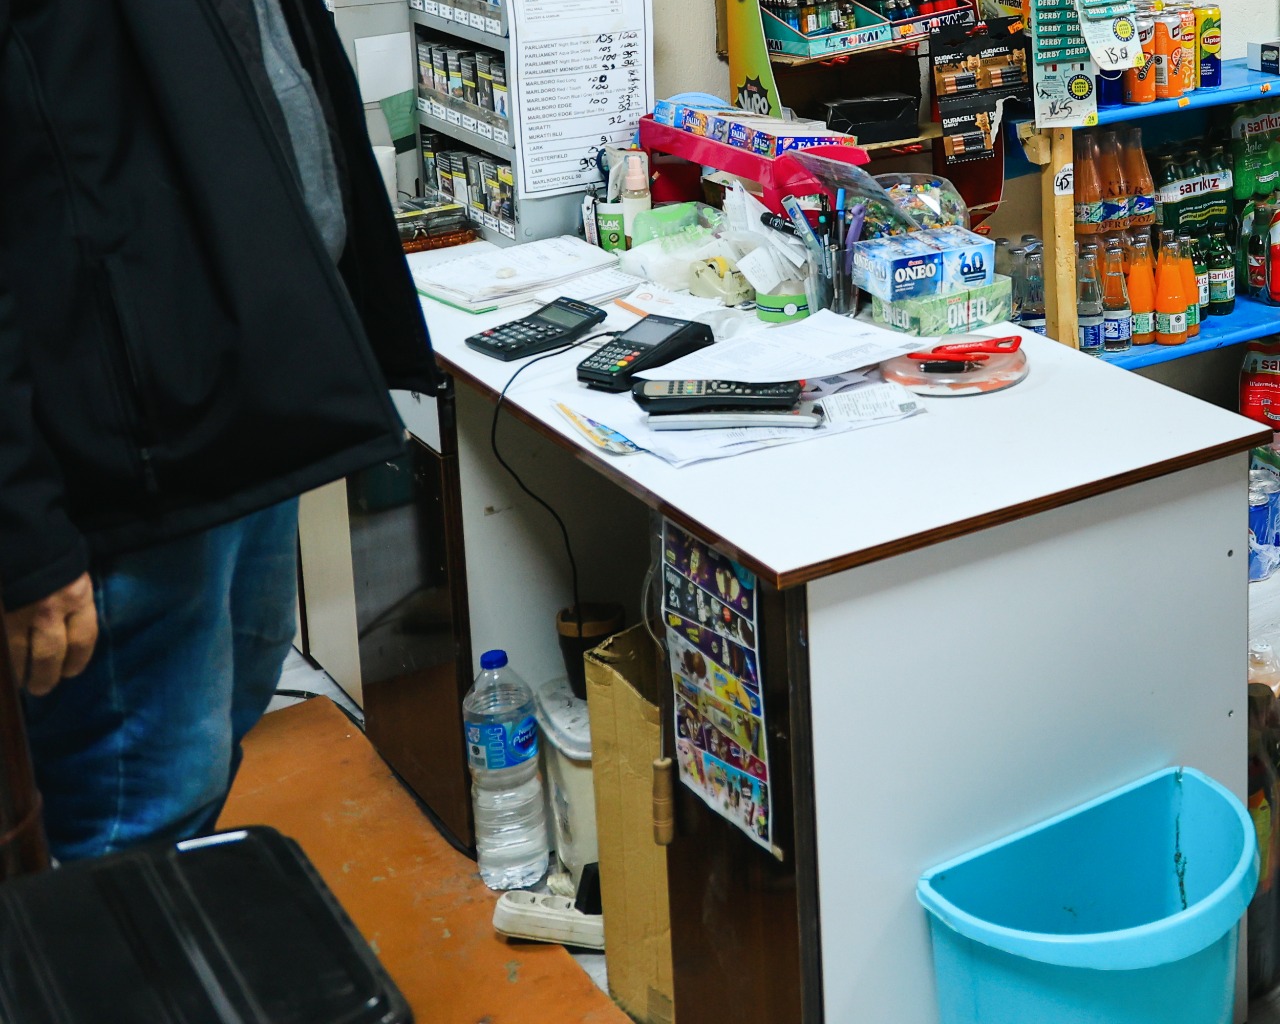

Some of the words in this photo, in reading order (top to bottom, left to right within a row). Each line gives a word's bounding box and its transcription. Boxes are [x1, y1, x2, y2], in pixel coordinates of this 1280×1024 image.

[840, 32, 880, 48] TOKAI
[1040, 38, 1062, 46] DERBY
[1067, 37, 1085, 45] DERB
[525, 43, 557, 51] PARLIAMENT
[525, 51, 558, 59] PARLIAMENT
[1037, 51, 1061, 59] DERBY
[1066, 47, 1088, 56] DERBY
[525, 60, 558, 68] PARLIAMENT
[525, 68, 558, 76] PARLIAMENT
[526, 78, 556, 87] MARLBORO
[943, 115, 975, 125] DURACELL
[1088, 115, 1095, 123] 24
[528, 124, 551, 132] MURATTI
[1179, 176, 1220, 196] sarıkız
[894, 263, 937, 283] ONEO
[1208, 270, 1235, 280] sarıkız
[947, 297, 987, 327] ONEO
[882, 306, 909, 330] ONEO
[490, 726, 505, 770] ULUDAĞ
